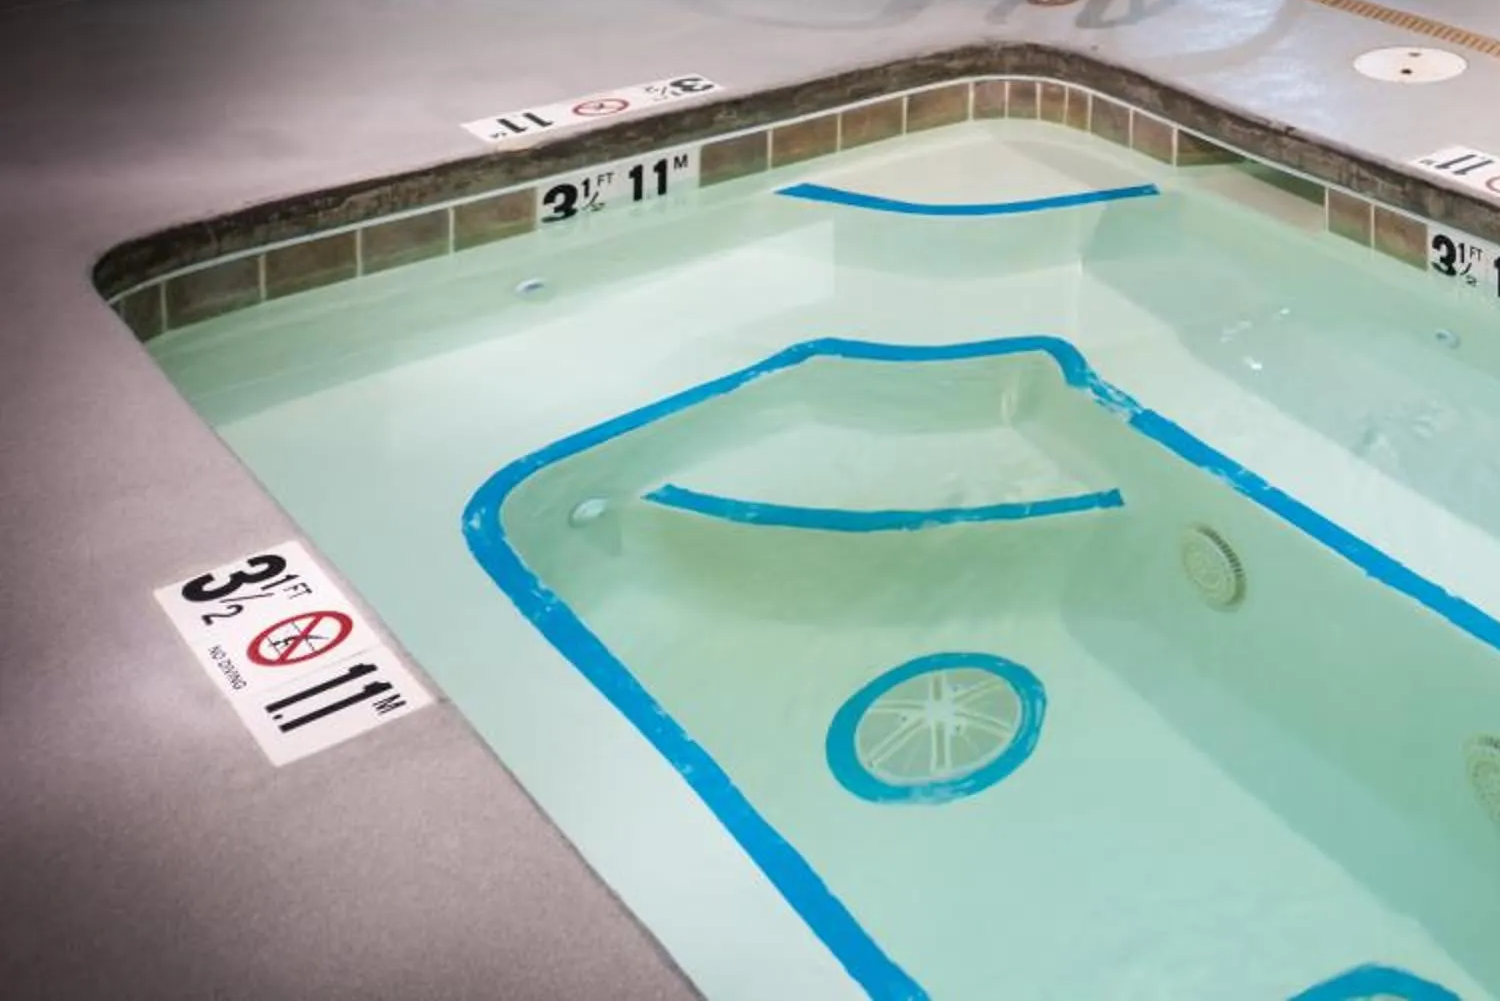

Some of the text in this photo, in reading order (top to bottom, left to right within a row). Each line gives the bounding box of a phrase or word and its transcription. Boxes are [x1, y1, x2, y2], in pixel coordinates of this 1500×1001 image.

[597, 172, 615, 187] FT
[674, 154, 689, 169] M
[1469, 246, 1483, 262] FT
[283, 581, 313, 599] FT
[372, 693, 408, 715] M
